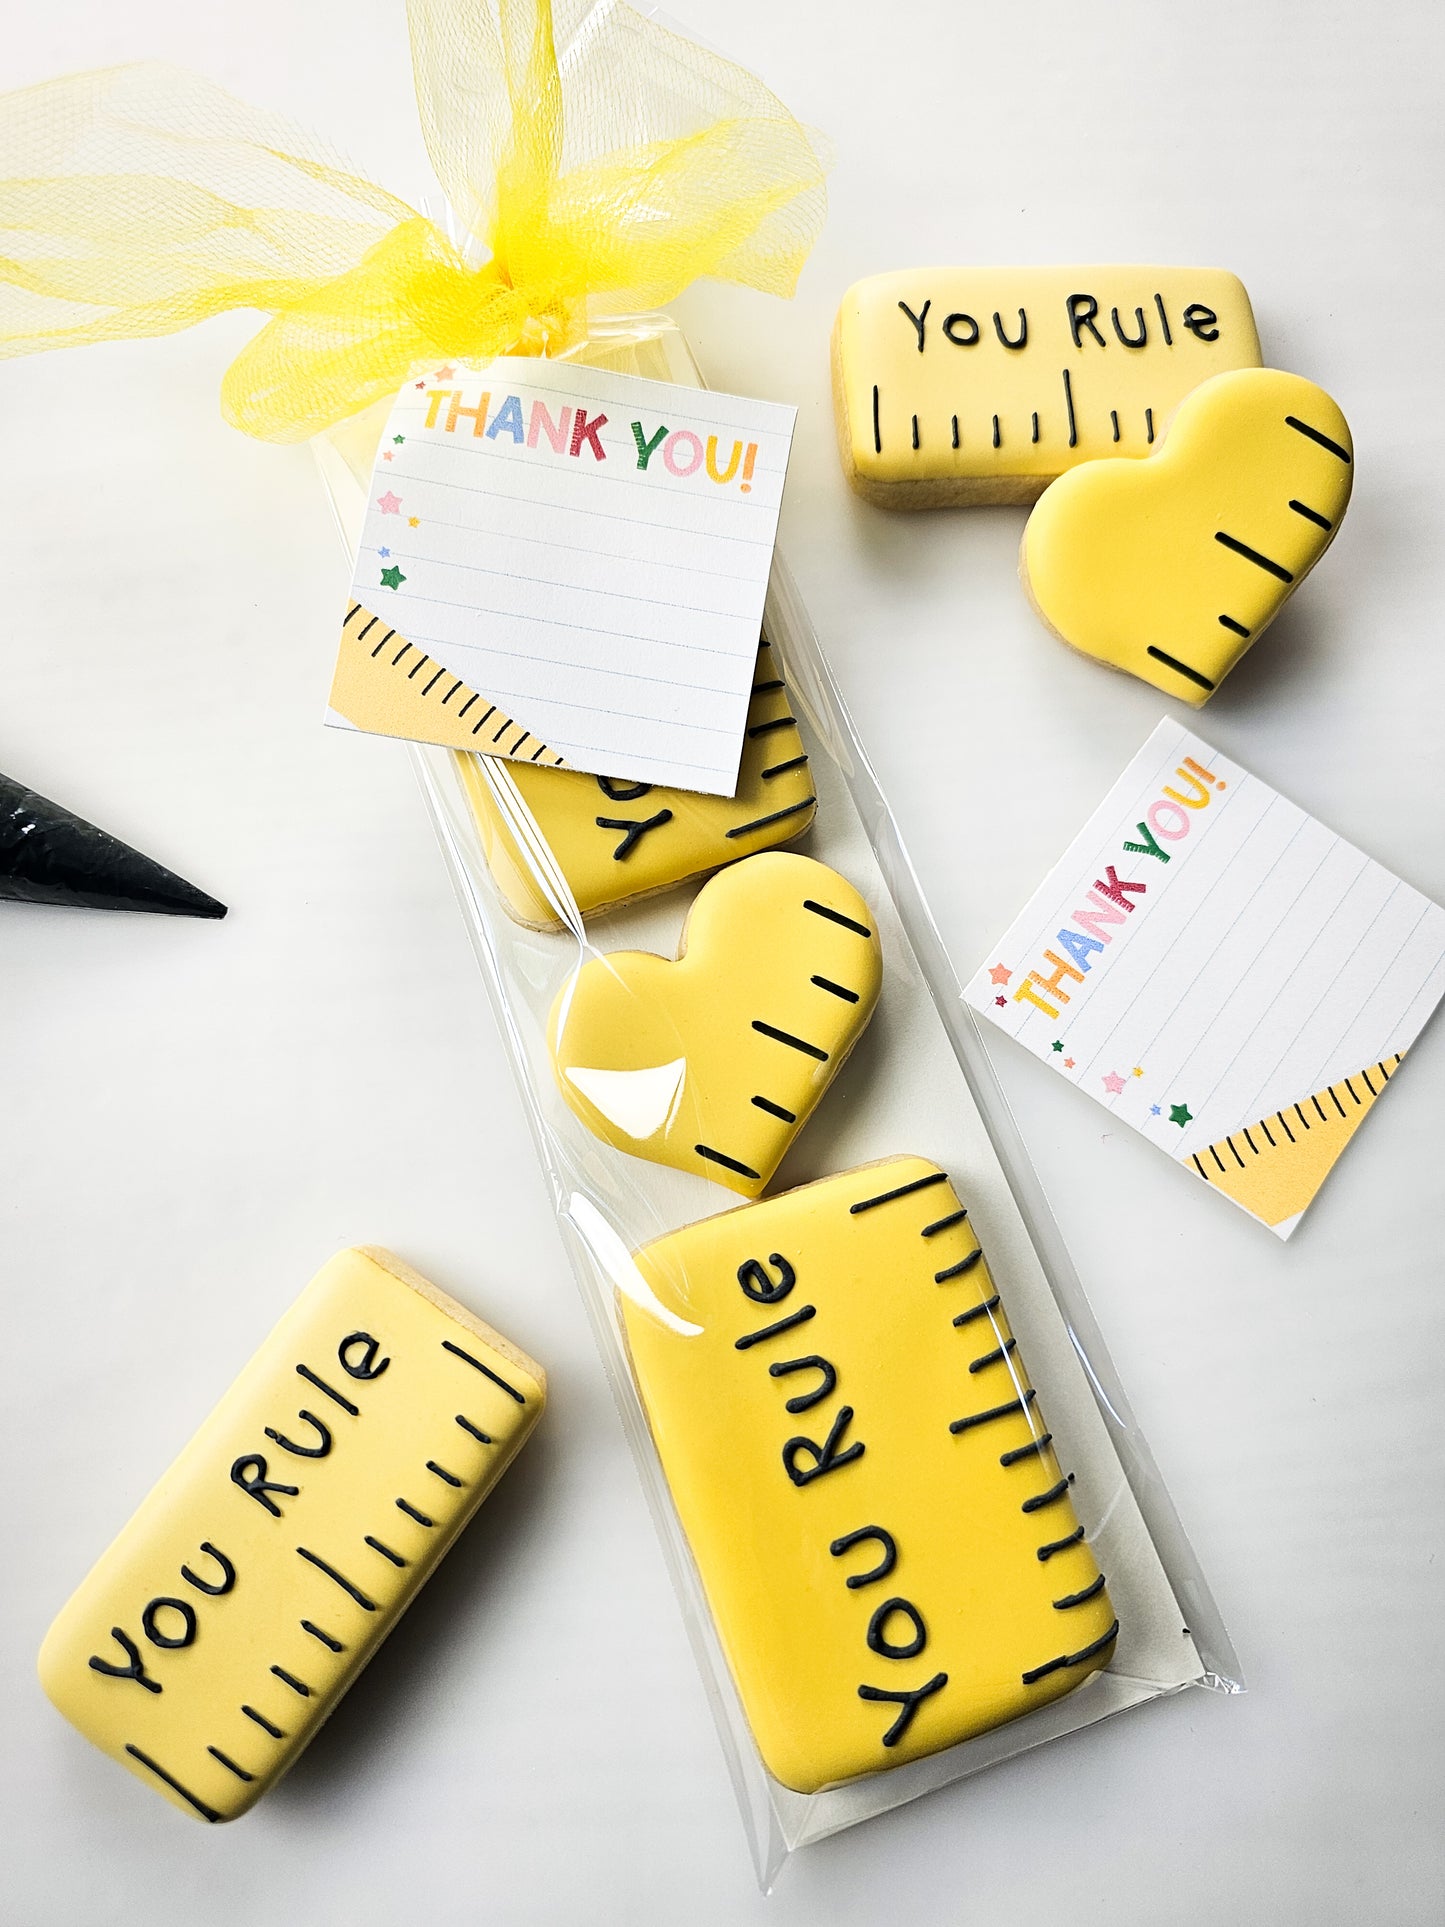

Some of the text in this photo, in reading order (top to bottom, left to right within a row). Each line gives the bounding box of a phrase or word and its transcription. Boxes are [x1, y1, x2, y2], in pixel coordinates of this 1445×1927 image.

[899, 293, 1220, 352] You Rule
[423, 390, 759, 494] THANK YOU!
[1013, 756, 1227, 1020] THANK YOU!
[735, 1252, 948, 1747] You Rule
